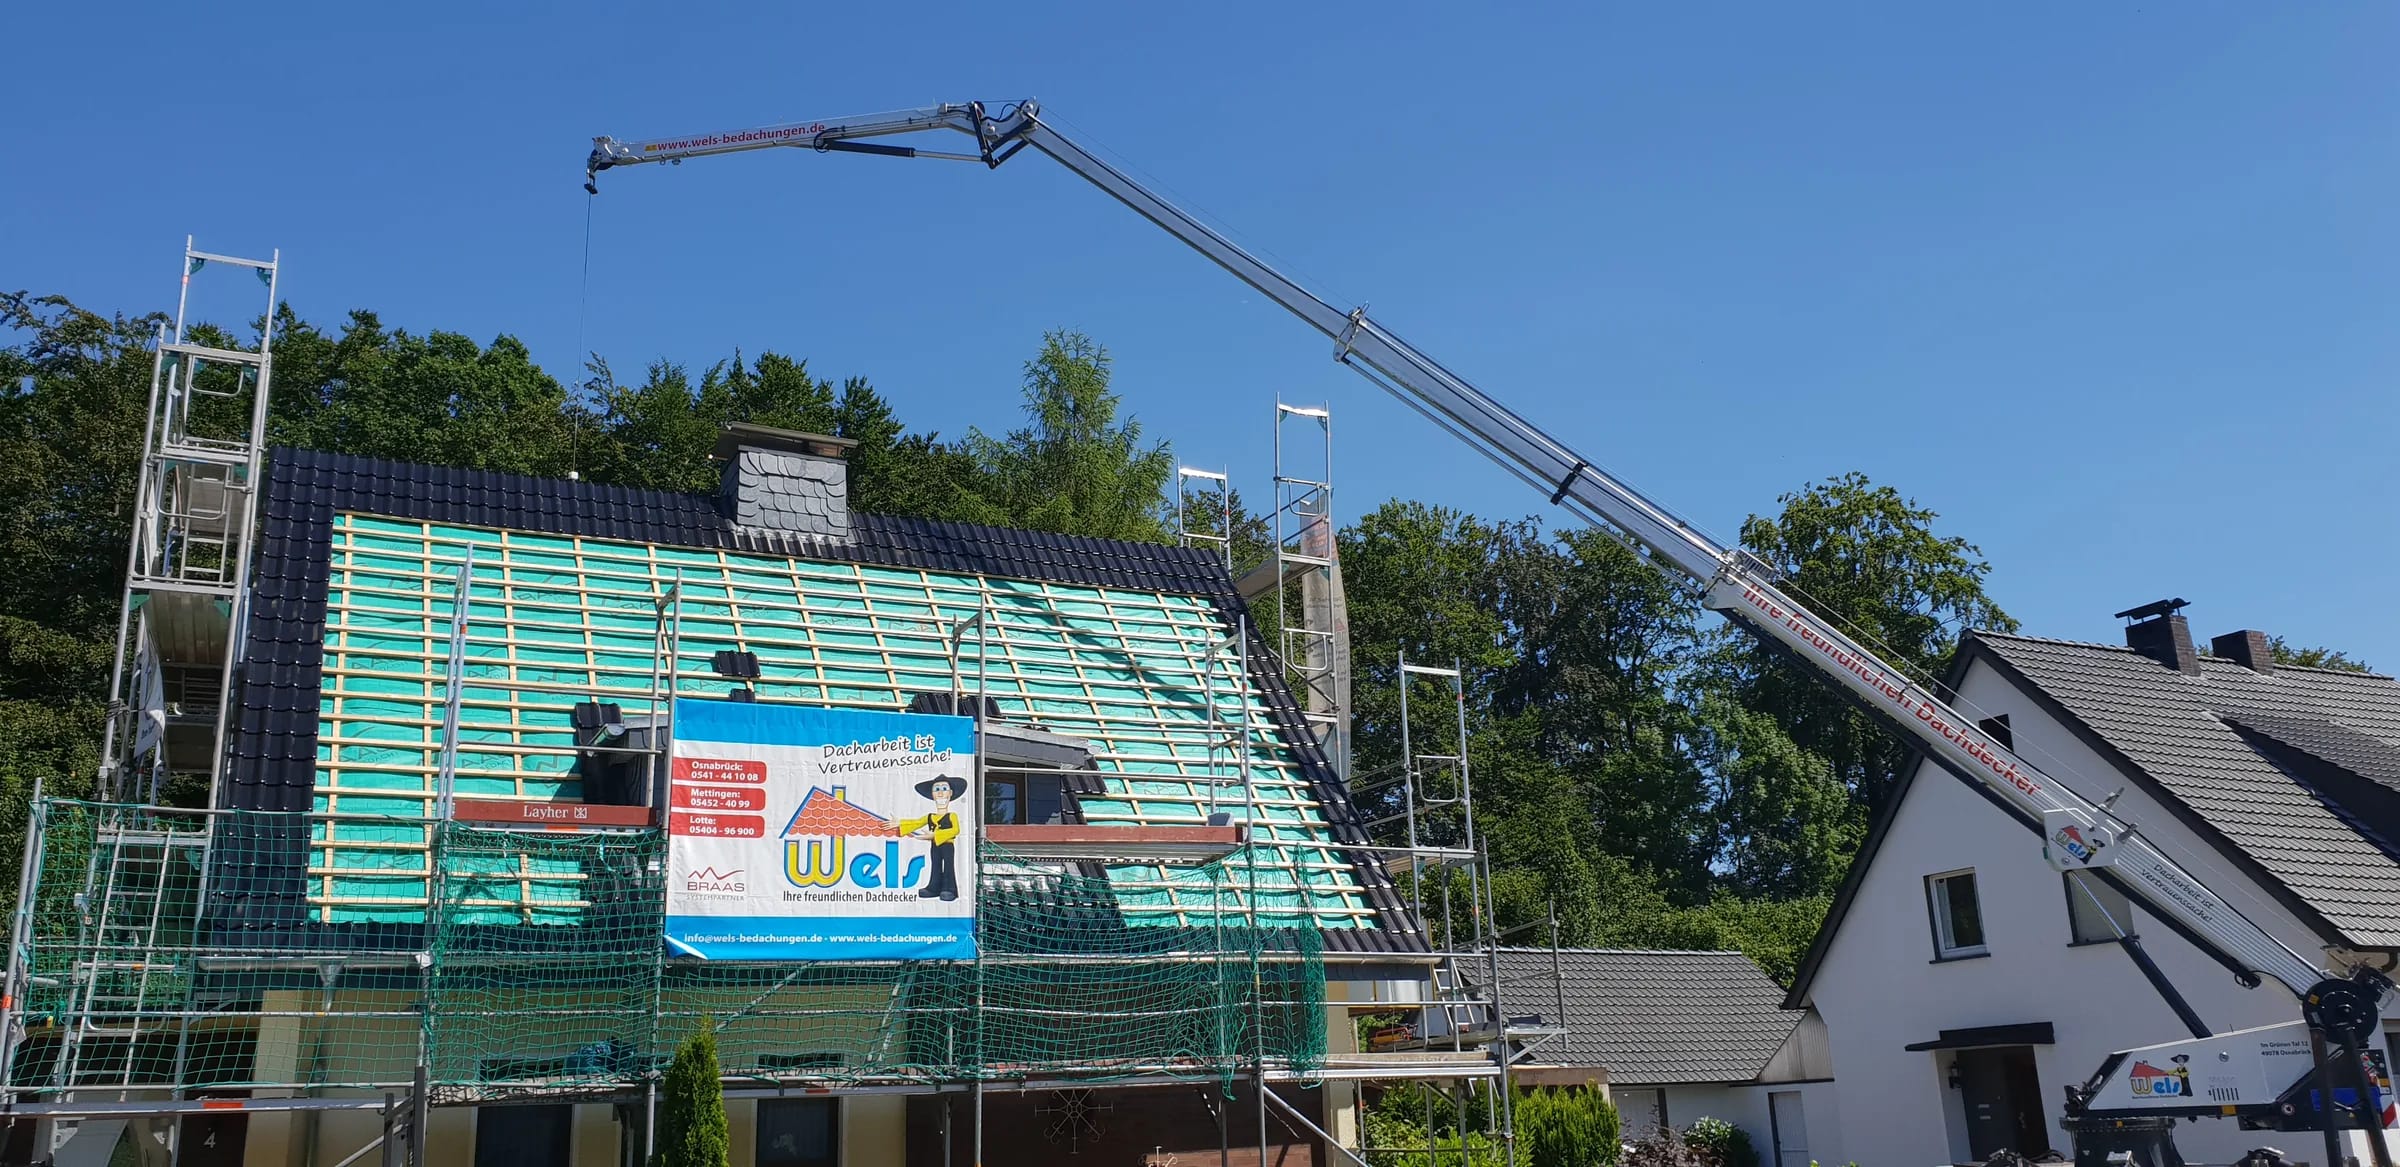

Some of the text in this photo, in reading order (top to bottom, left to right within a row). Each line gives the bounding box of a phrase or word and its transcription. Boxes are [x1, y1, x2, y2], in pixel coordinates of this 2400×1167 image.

[658, 123, 825, 150] www.wels-bedachungen.de
[1743, 583, 2042, 796] Ihre freundlichen Dachdecker
[823, 735, 935, 759] Dacharbeit ist
[691, 761, 743, 771] Osnabrück:
[818, 749, 952, 775] Vertrauenssache!
[691, 771, 713, 779] 0541
[747, 773, 759, 781] 08
[691, 789, 741, 800] Mettingen:
[690, 798, 719, 807] 05452
[738, 800, 750, 808] 99
[523, 804, 569, 820] Layher
[690, 815, 716, 825] Lotte:
[689, 825, 717, 834] 05404
[724, 827, 736, 835] 96
[738, 827, 755, 835] 900
[2055, 830, 2087, 857] Wels
[784, 836, 926, 889] Wels
[687, 881, 745, 892] BRAAS
[2153, 864, 2202, 901] Dacharbeit
[783, 890, 918, 903] Ihre freundlichen Dachdecker
[829, 933, 958, 945] www.wels-bedachungen.de
[2130, 1075, 2180, 1095] Wels
[203, 1131, 216, 1149] 4
